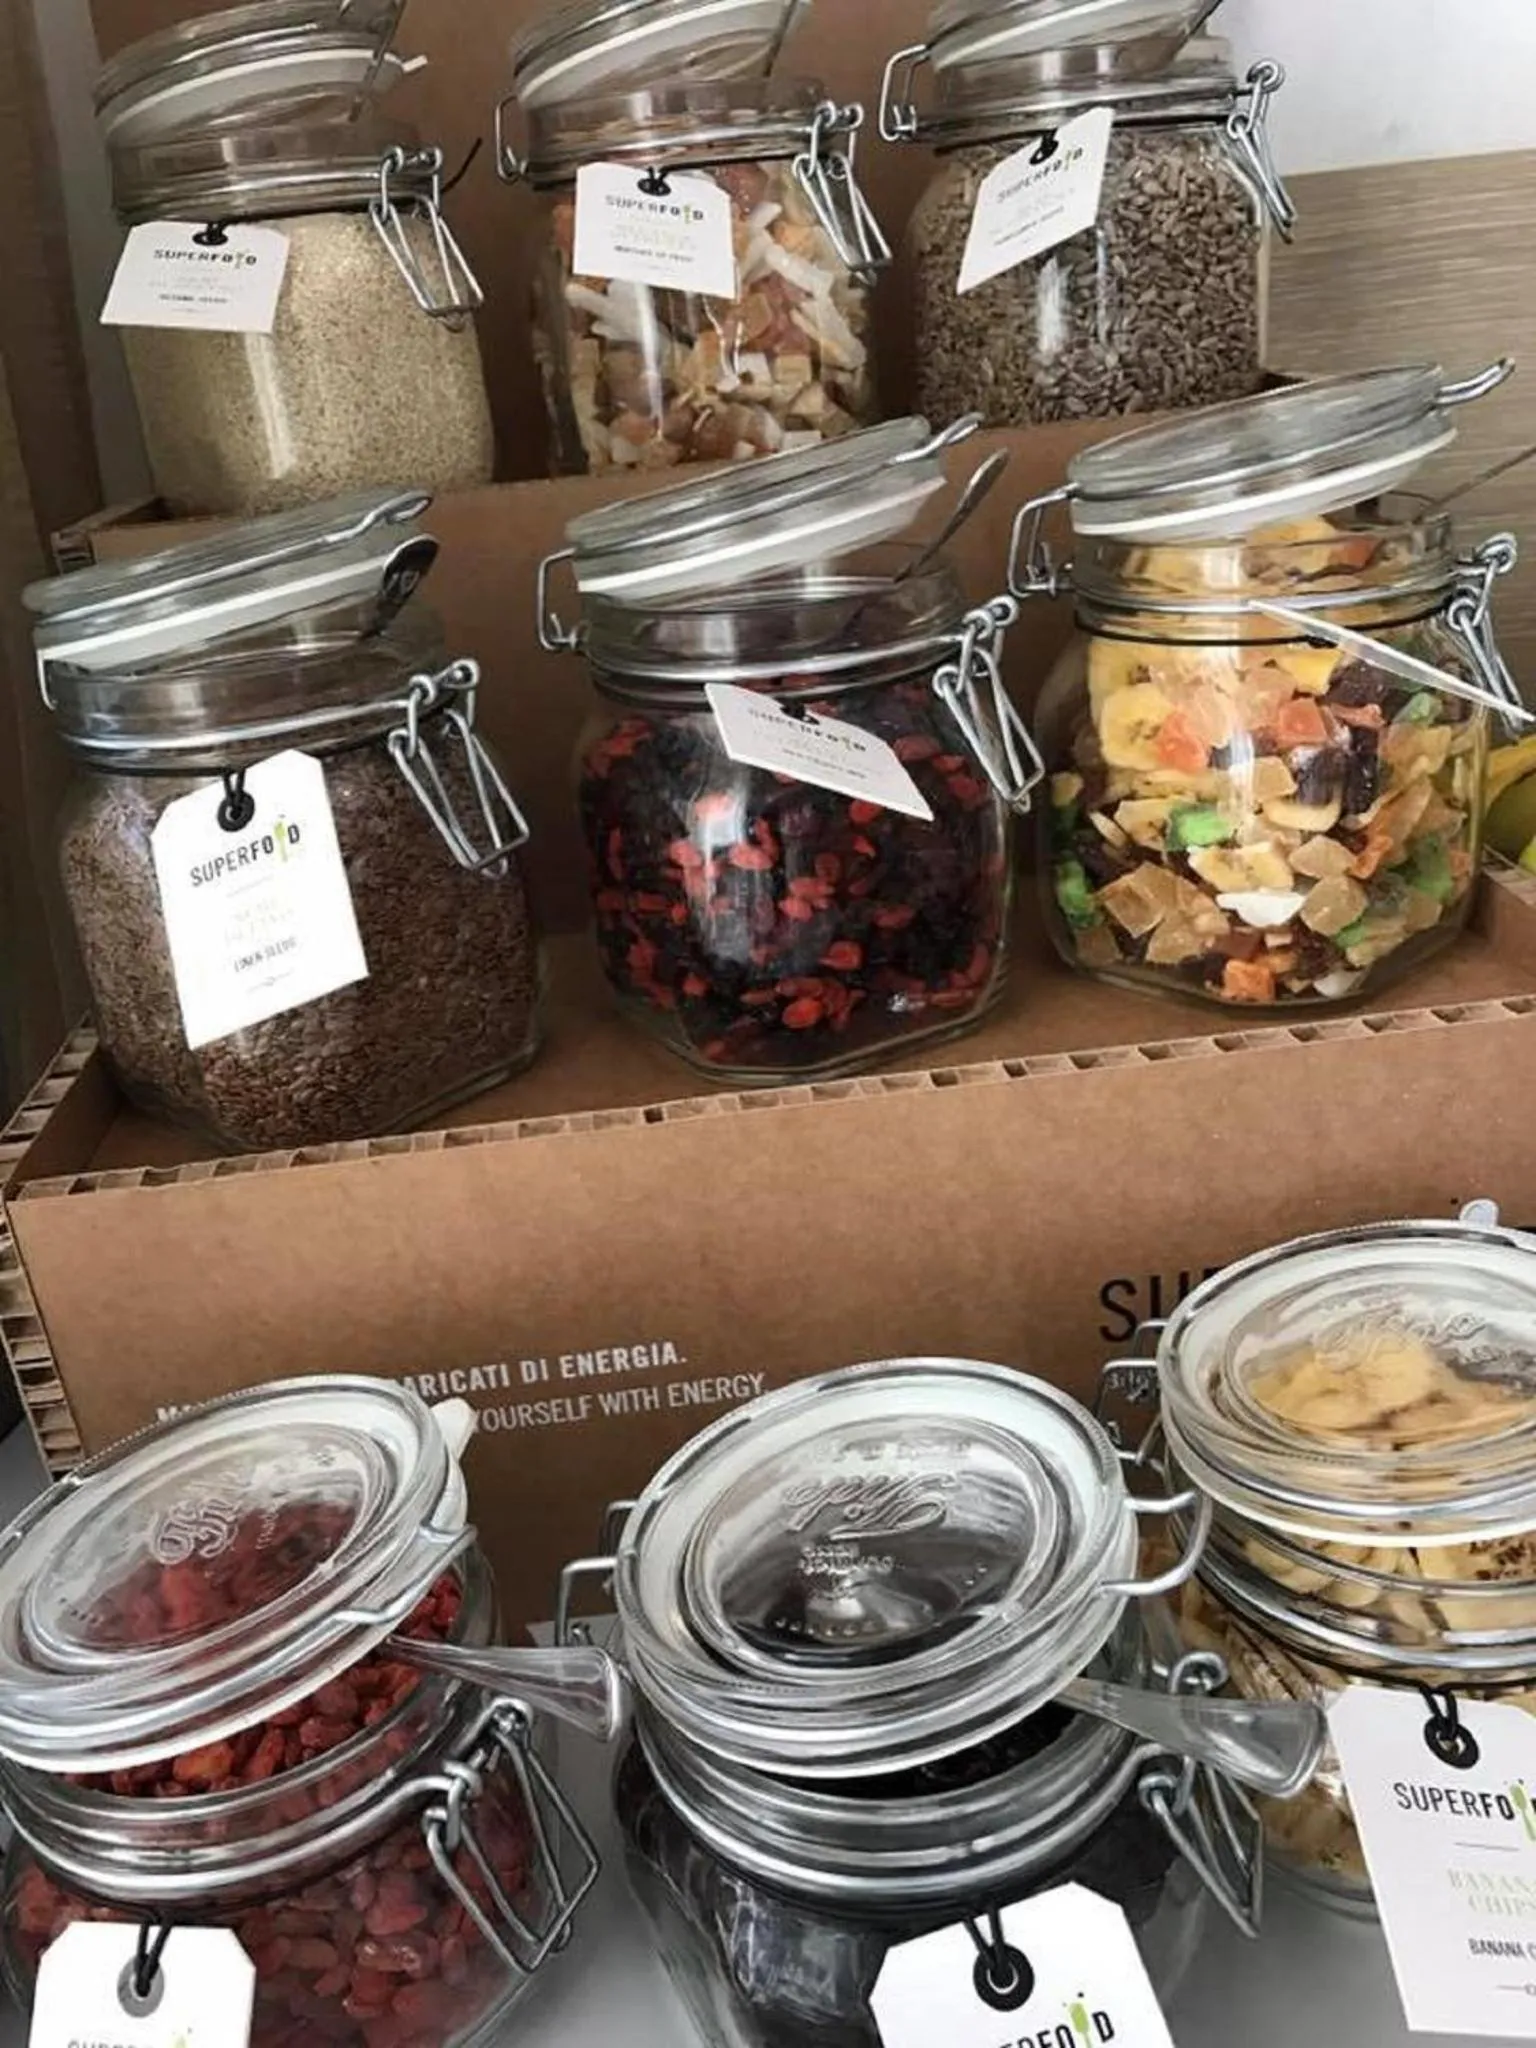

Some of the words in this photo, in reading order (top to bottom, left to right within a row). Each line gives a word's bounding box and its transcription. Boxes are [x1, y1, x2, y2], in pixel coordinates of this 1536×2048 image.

[521, 1358, 549, 1383] DI
[560, 1341, 688, 1379] ENERGIA.
[599, 1386, 660, 1416] WITH
